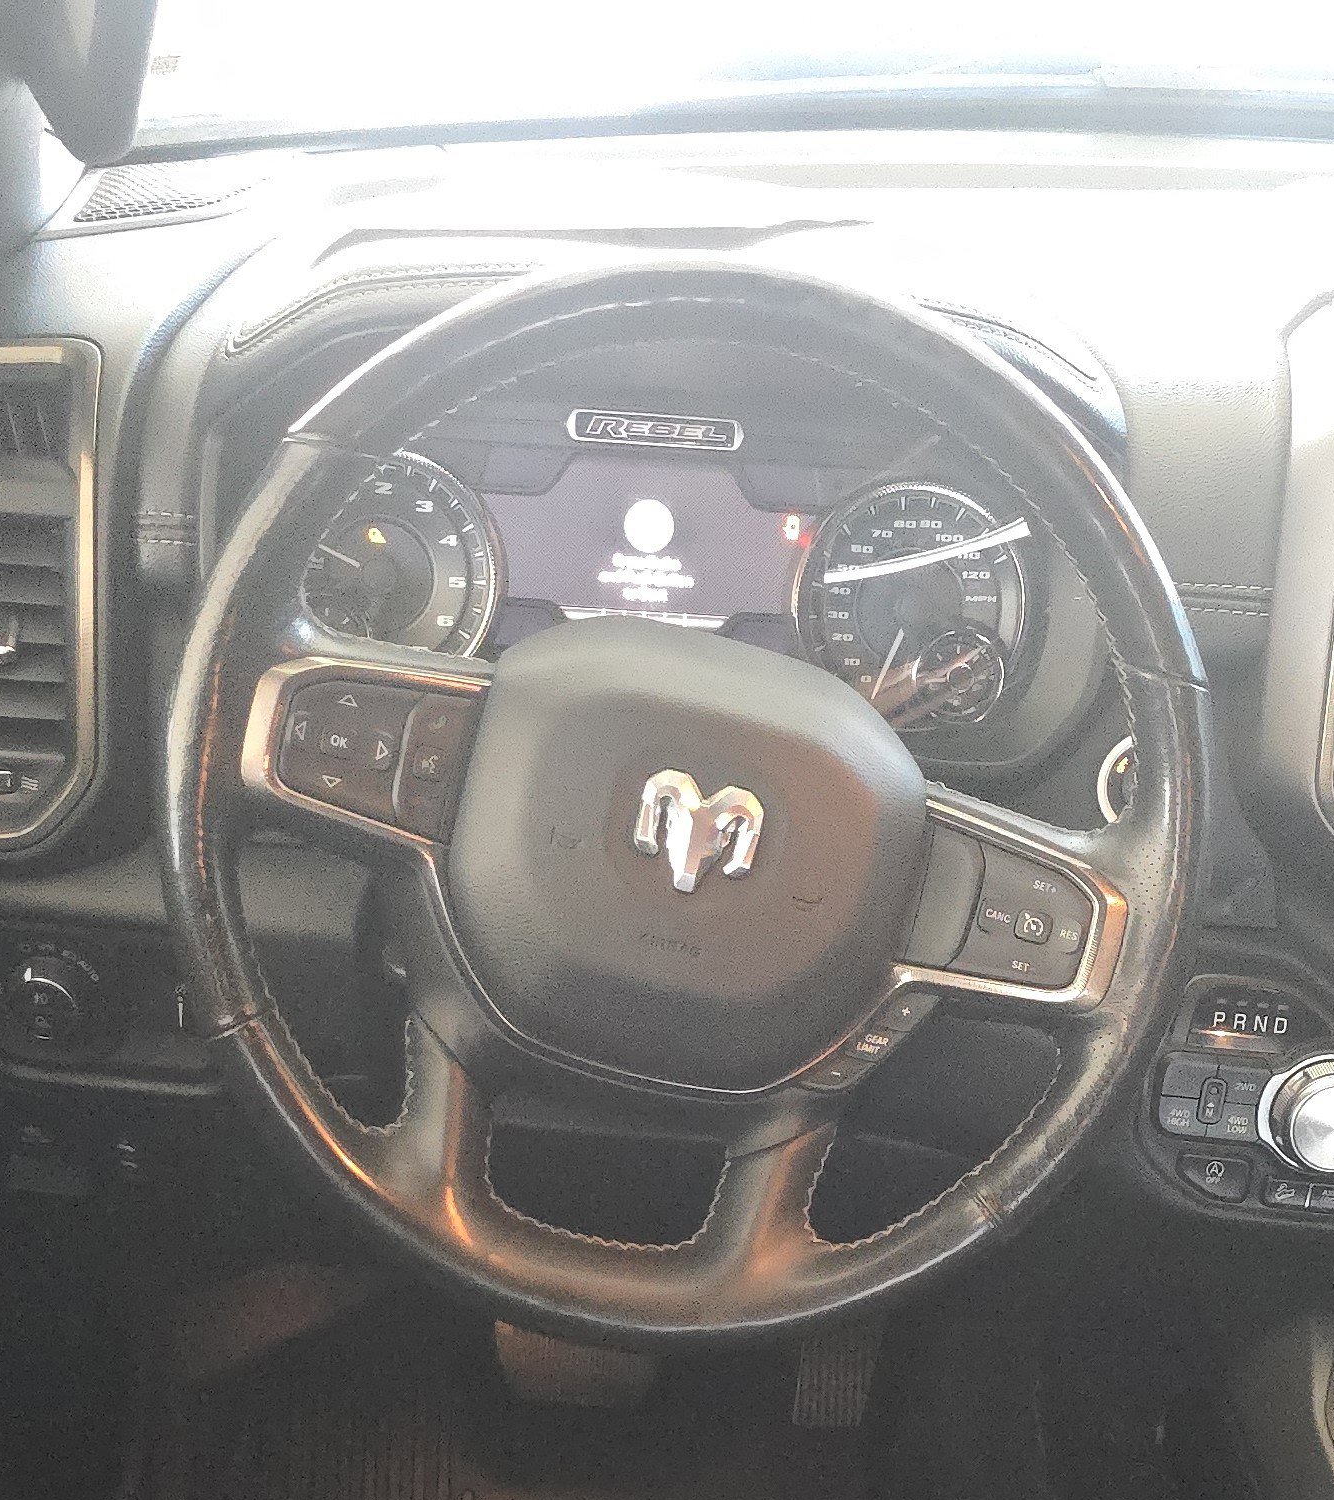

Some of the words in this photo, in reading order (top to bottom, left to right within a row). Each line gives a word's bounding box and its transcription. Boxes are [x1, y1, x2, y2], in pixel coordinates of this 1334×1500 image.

[586, 415, 727, 442] REBEL
[374, 481, 393, 495] 2
[415, 500, 434, 513] 3
[872, 529, 893, 538] 70
[935, 533, 964, 542] 100
[438, 534, 458, 547] 4
[962, 570, 990, 580] 120
[448, 576, 466, 589] 5
[828, 587, 851, 596] 40
[965, 595, 997, 603] MPH
[436, 615, 454, 627] 6
[827, 611, 849, 620] 30
[832, 632, 854, 642] 20
[844, 658, 861, 667] 10
[330, 734, 348, 749] OK
[985, 908, 1011, 924] CANC
[1059, 928, 1078, 941] RES
[1012, 960, 1030, 972] SET
[1213, 1011, 1225, 1027] P
[1233, 1013, 1247, 1030] R
[1253, 1015, 1268, 1032] N
[1273, 1017, 1288, 1034] D
[865, 1034, 889, 1046] GEAR
[1234, 1082, 1256, 1092] 2WD
[1169, 1108, 1190, 1118] 4WD
[1167, 1117, 1190, 1128] HIGH
[1227, 1116, 1249, 1126] 4WD
[1227, 1125, 1247, 1134] LOW
